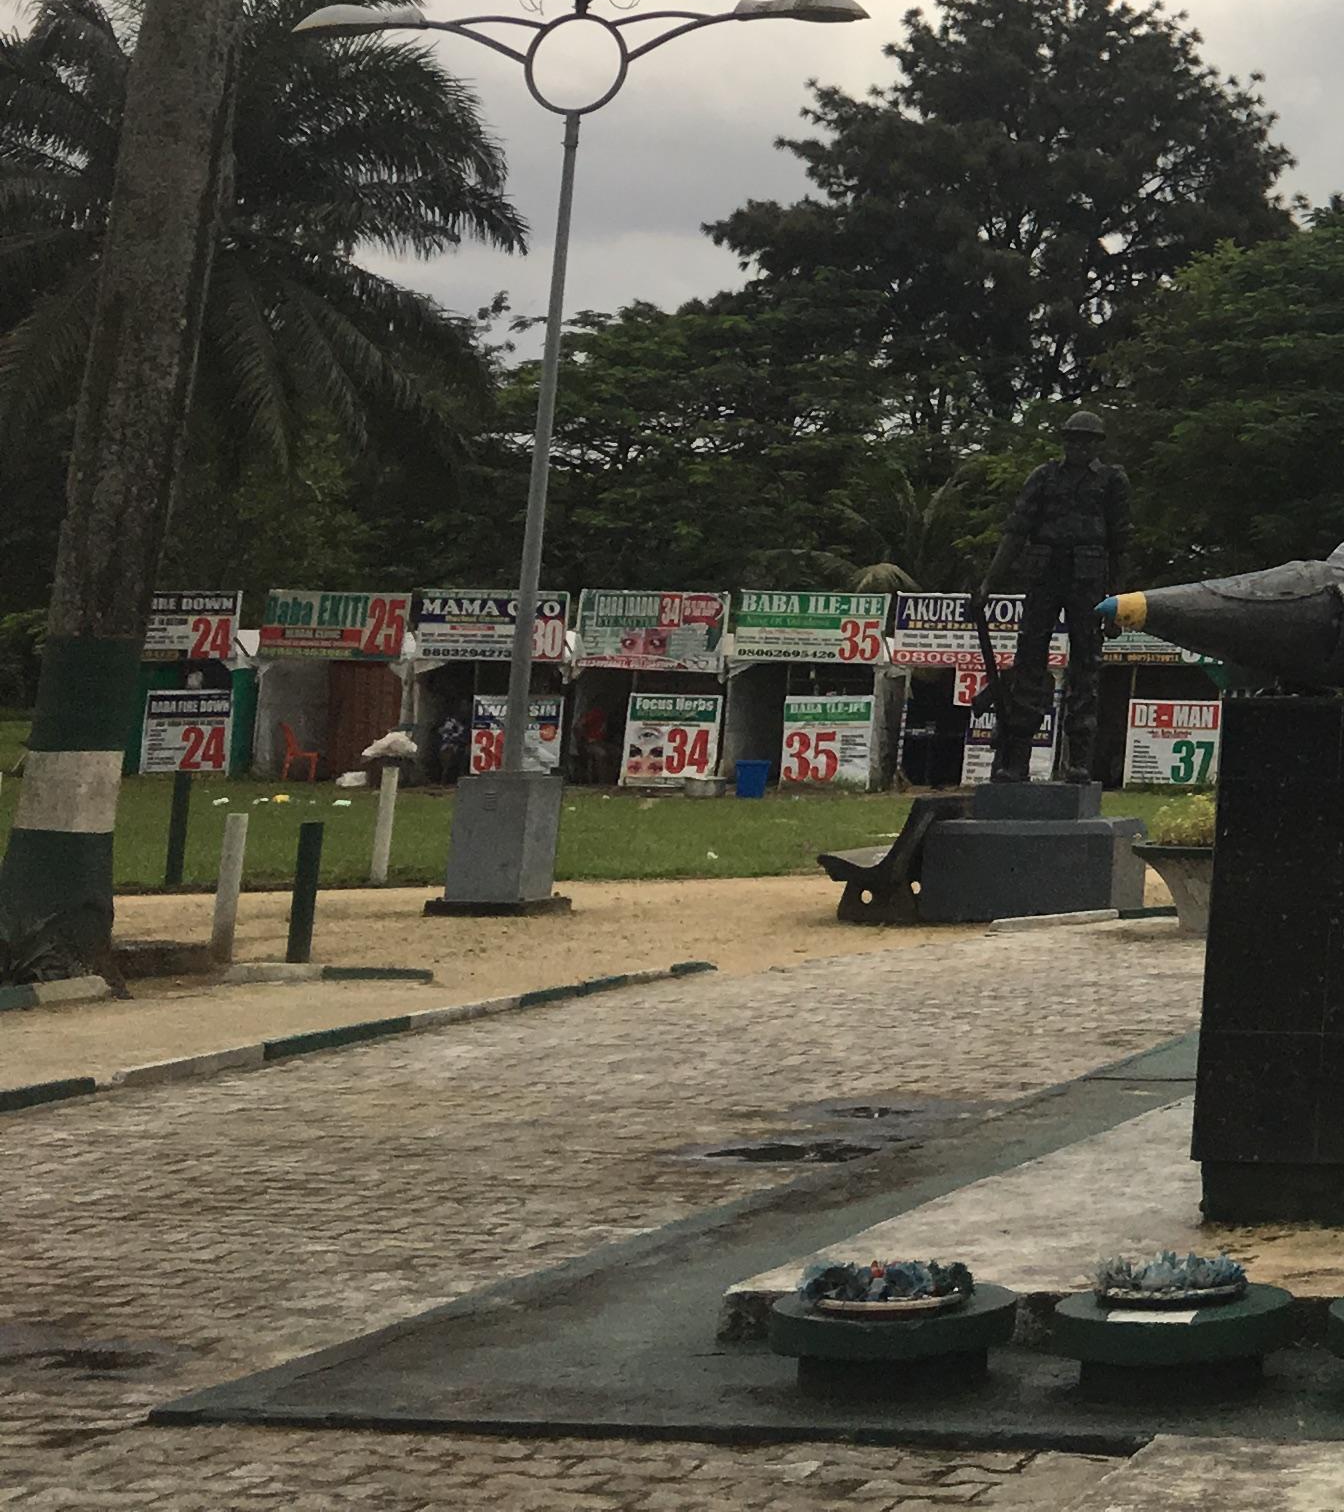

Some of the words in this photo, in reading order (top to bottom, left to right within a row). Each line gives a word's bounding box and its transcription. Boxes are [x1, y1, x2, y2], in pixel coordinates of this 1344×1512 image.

[181, 598, 233, 610] DOWN
[264, 595, 313, 626] Baba
[317, 594, 370, 627] EKITI
[421, 599, 500, 615] MAMA
[507, 600, 561, 616] OO
[661, 598, 681, 625] 34
[741, 594, 800, 613] BABA
[808, 596, 882, 615] ILE-IFE
[902, 598, 965, 622] AKURE
[191, 617, 231, 659] 24
[363, 598, 406, 656] 25
[530, 619, 563, 658] 30
[838, 619, 881, 661] 35
[636, 697, 673, 710] Focus
[676, 698, 714, 711] Herbs
[1135, 704, 1157, 726] DE
[1172, 705, 1214, 728] MAN
[179, 727, 225, 769] 24
[665, 727, 709, 774] 34
[783, 731, 838, 782] 35
[1171, 740, 1215, 784] 37
